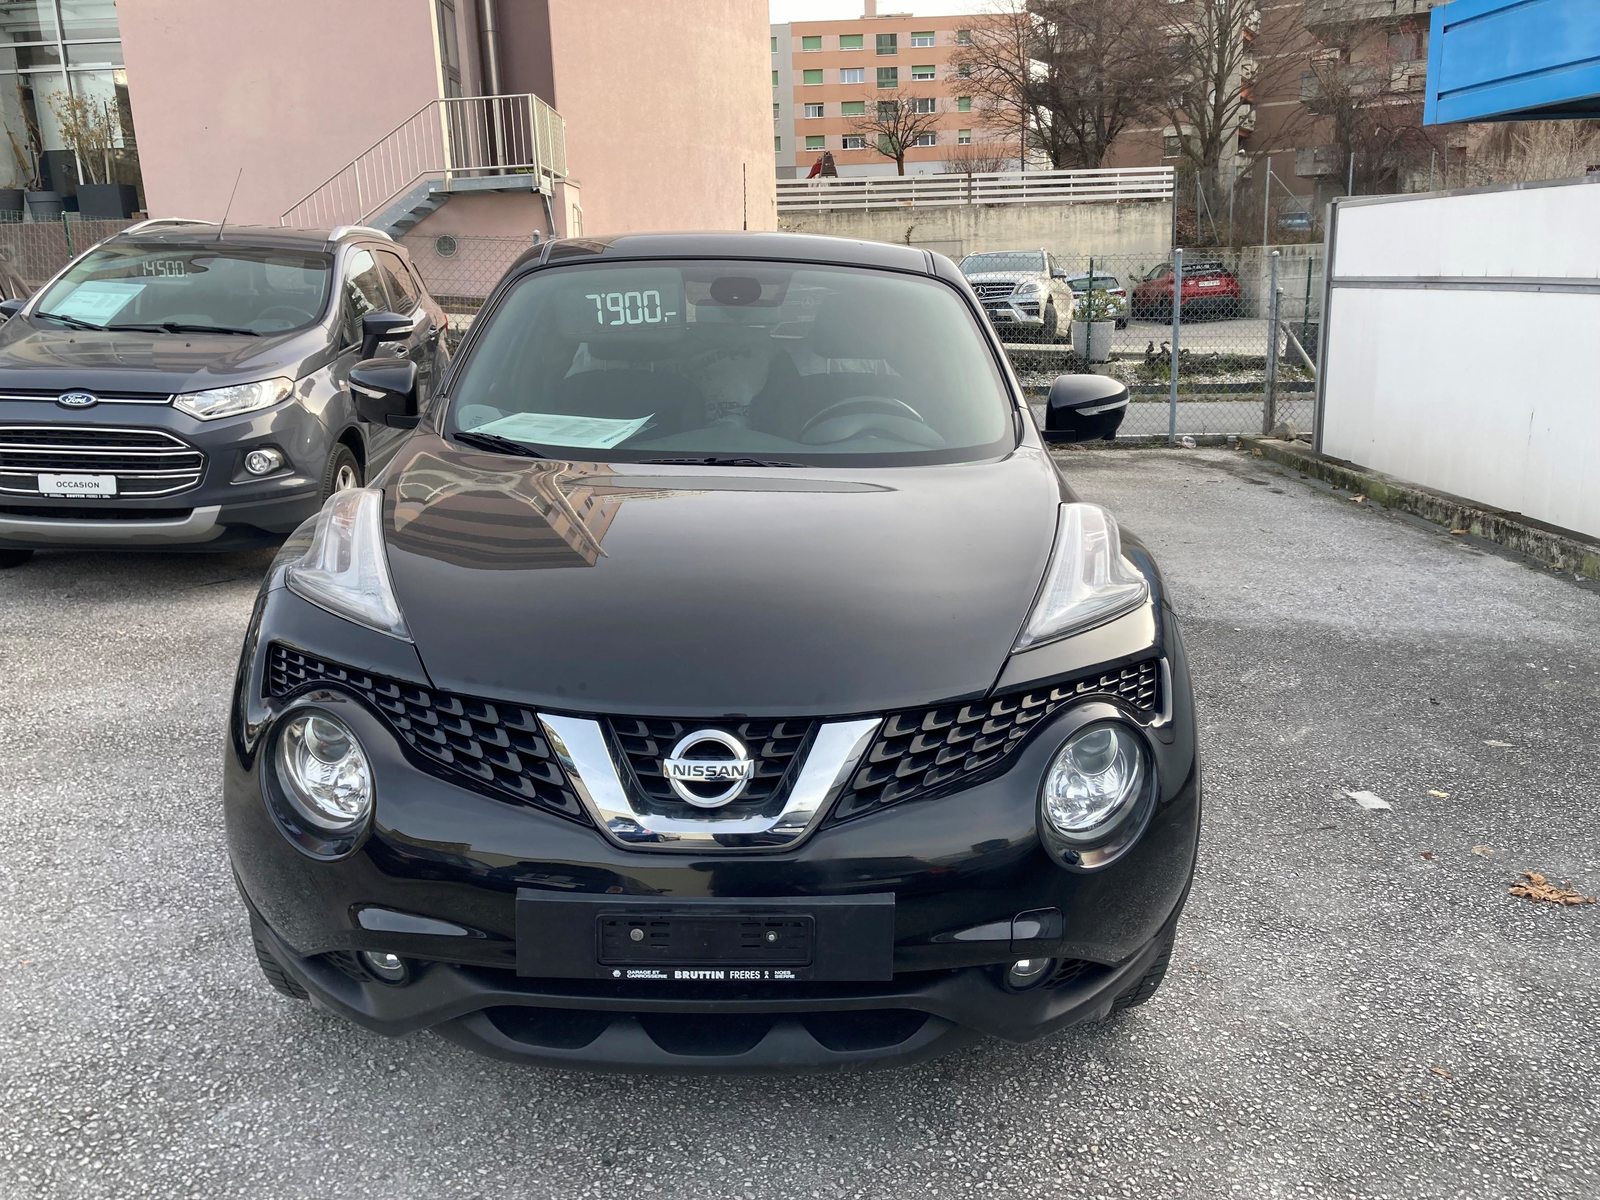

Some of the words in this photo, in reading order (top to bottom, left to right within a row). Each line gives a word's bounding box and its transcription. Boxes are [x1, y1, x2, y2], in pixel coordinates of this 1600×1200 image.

[65, 395, 88, 403] Ford
[56, 481, 100, 489] OCCASION
[673, 764, 744, 777] NISSAN
[674, 970, 724, 979] BRUTTIN
